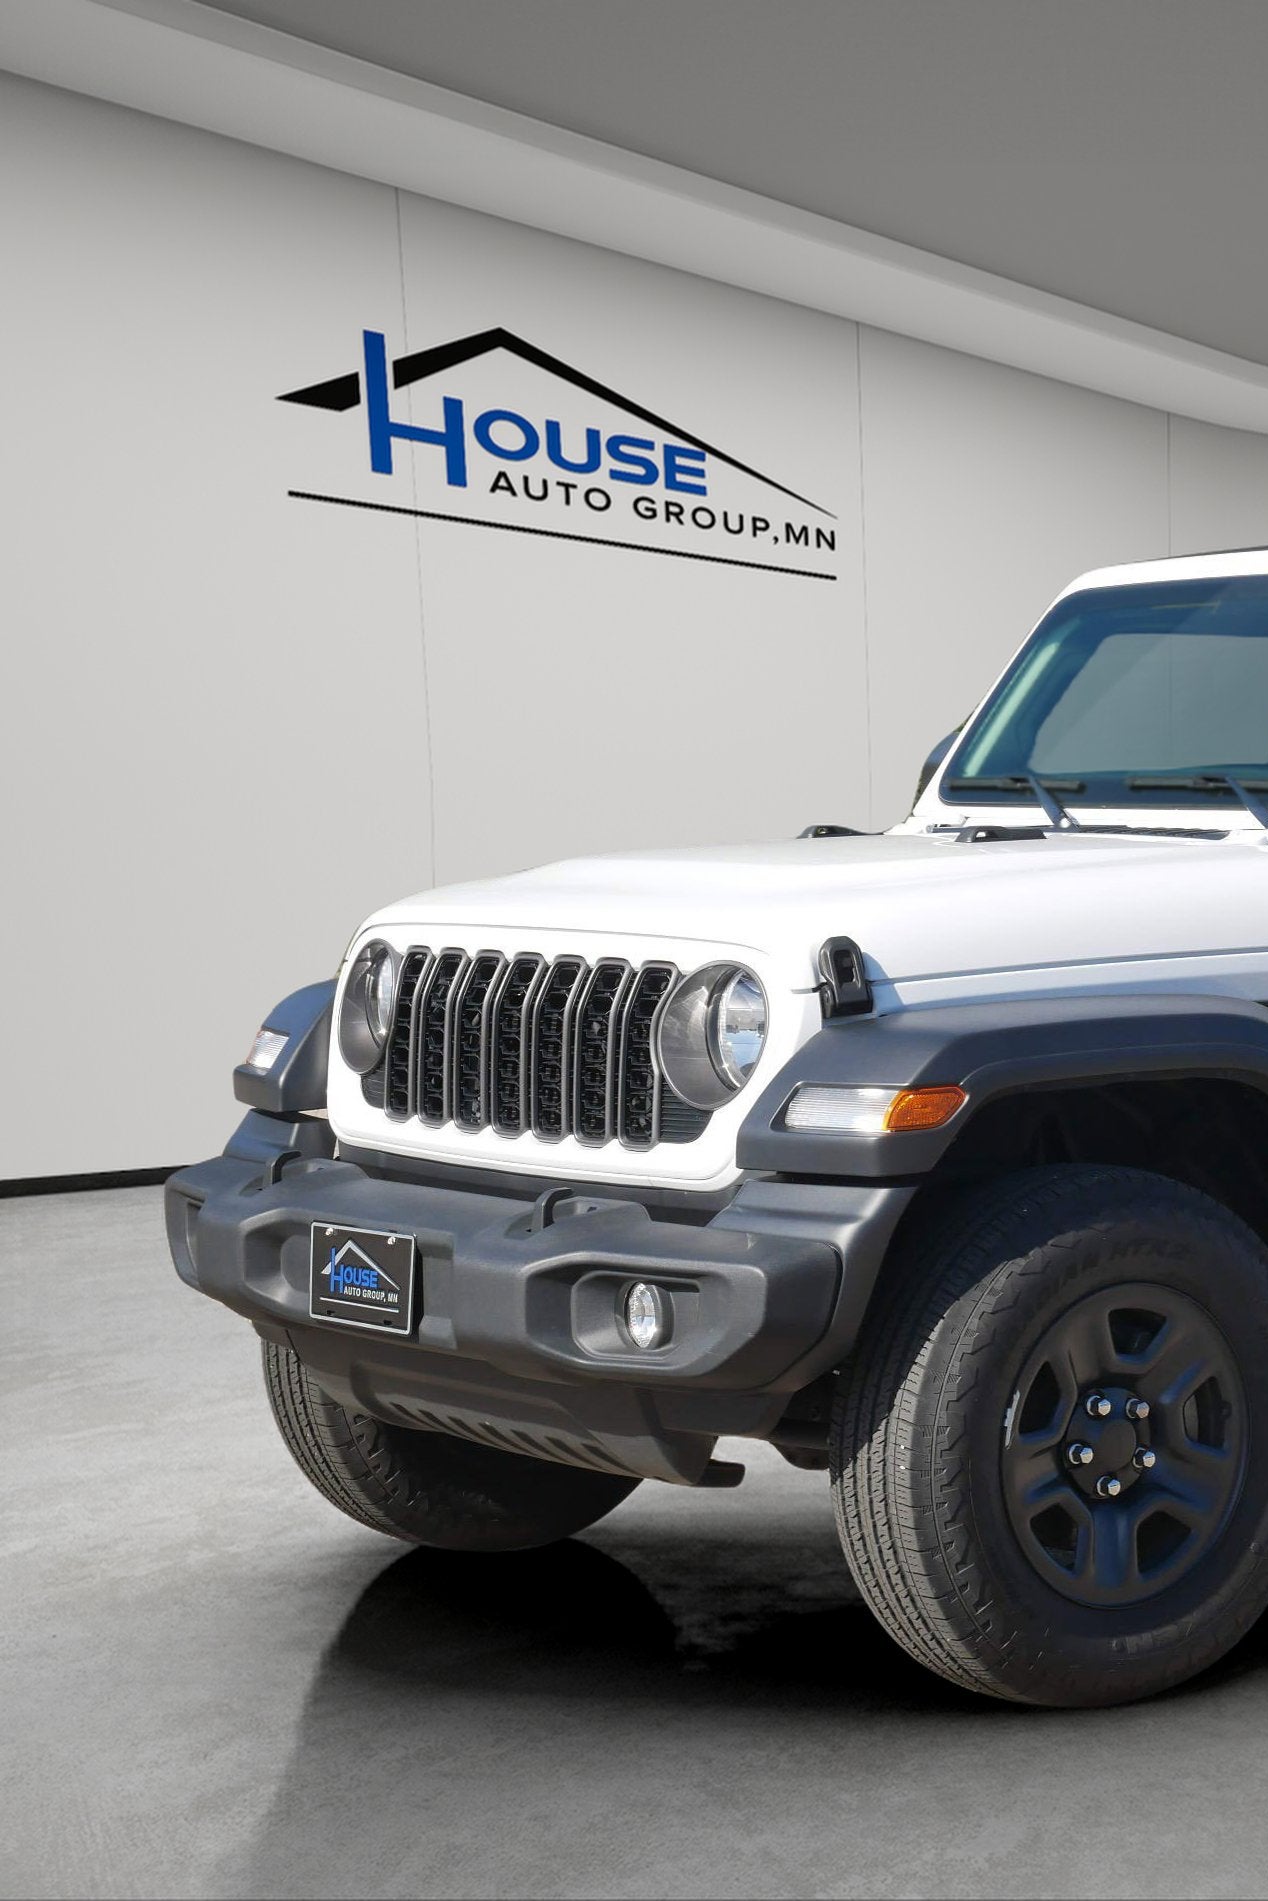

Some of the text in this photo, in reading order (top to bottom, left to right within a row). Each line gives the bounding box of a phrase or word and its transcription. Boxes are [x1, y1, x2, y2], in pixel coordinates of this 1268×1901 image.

[363, 330, 708, 497] HOUSE
[490, 470, 612, 512] AUTO
[330, 1247, 379, 1293] HOUSE
[343, 1285, 361, 1297] AUTO
